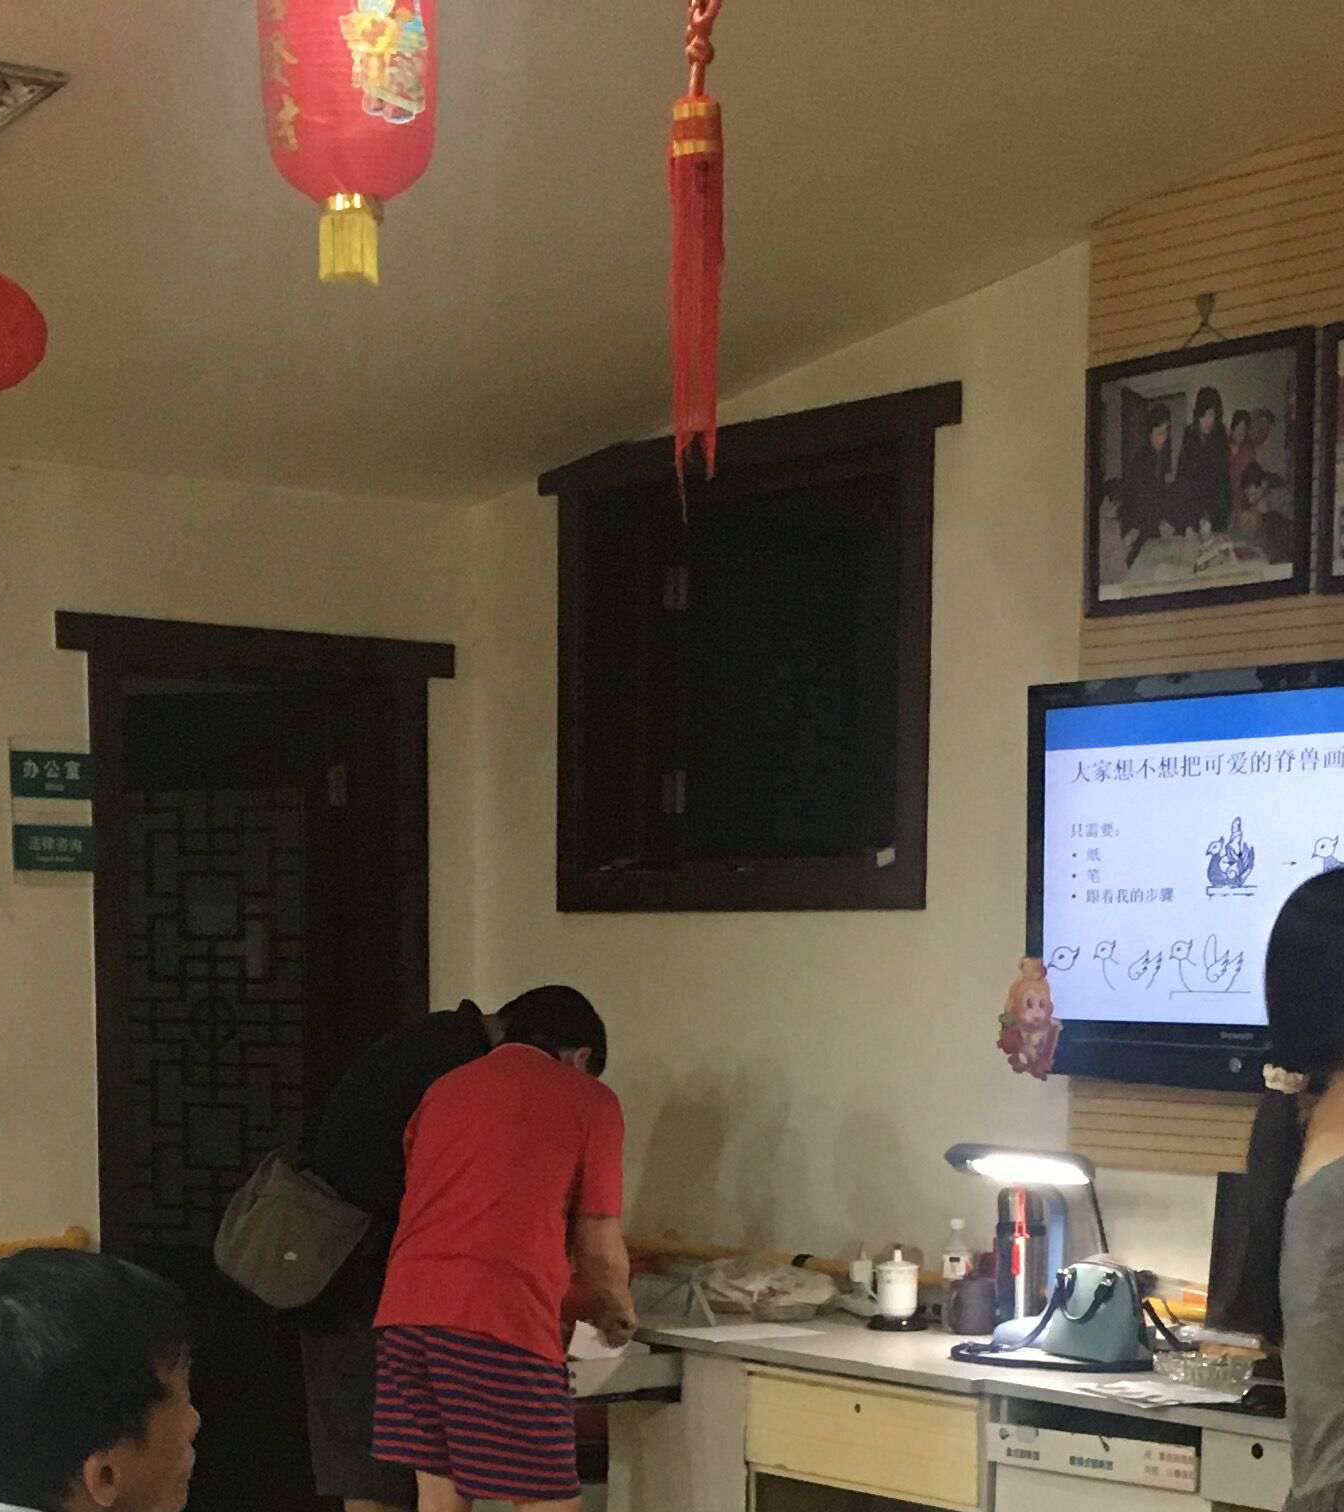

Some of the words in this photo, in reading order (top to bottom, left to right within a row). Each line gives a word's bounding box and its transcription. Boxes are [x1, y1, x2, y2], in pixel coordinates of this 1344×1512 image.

[23, 759, 81, 780] 办公室
[1086, 887, 1175, 904] 跟着我的步骤
